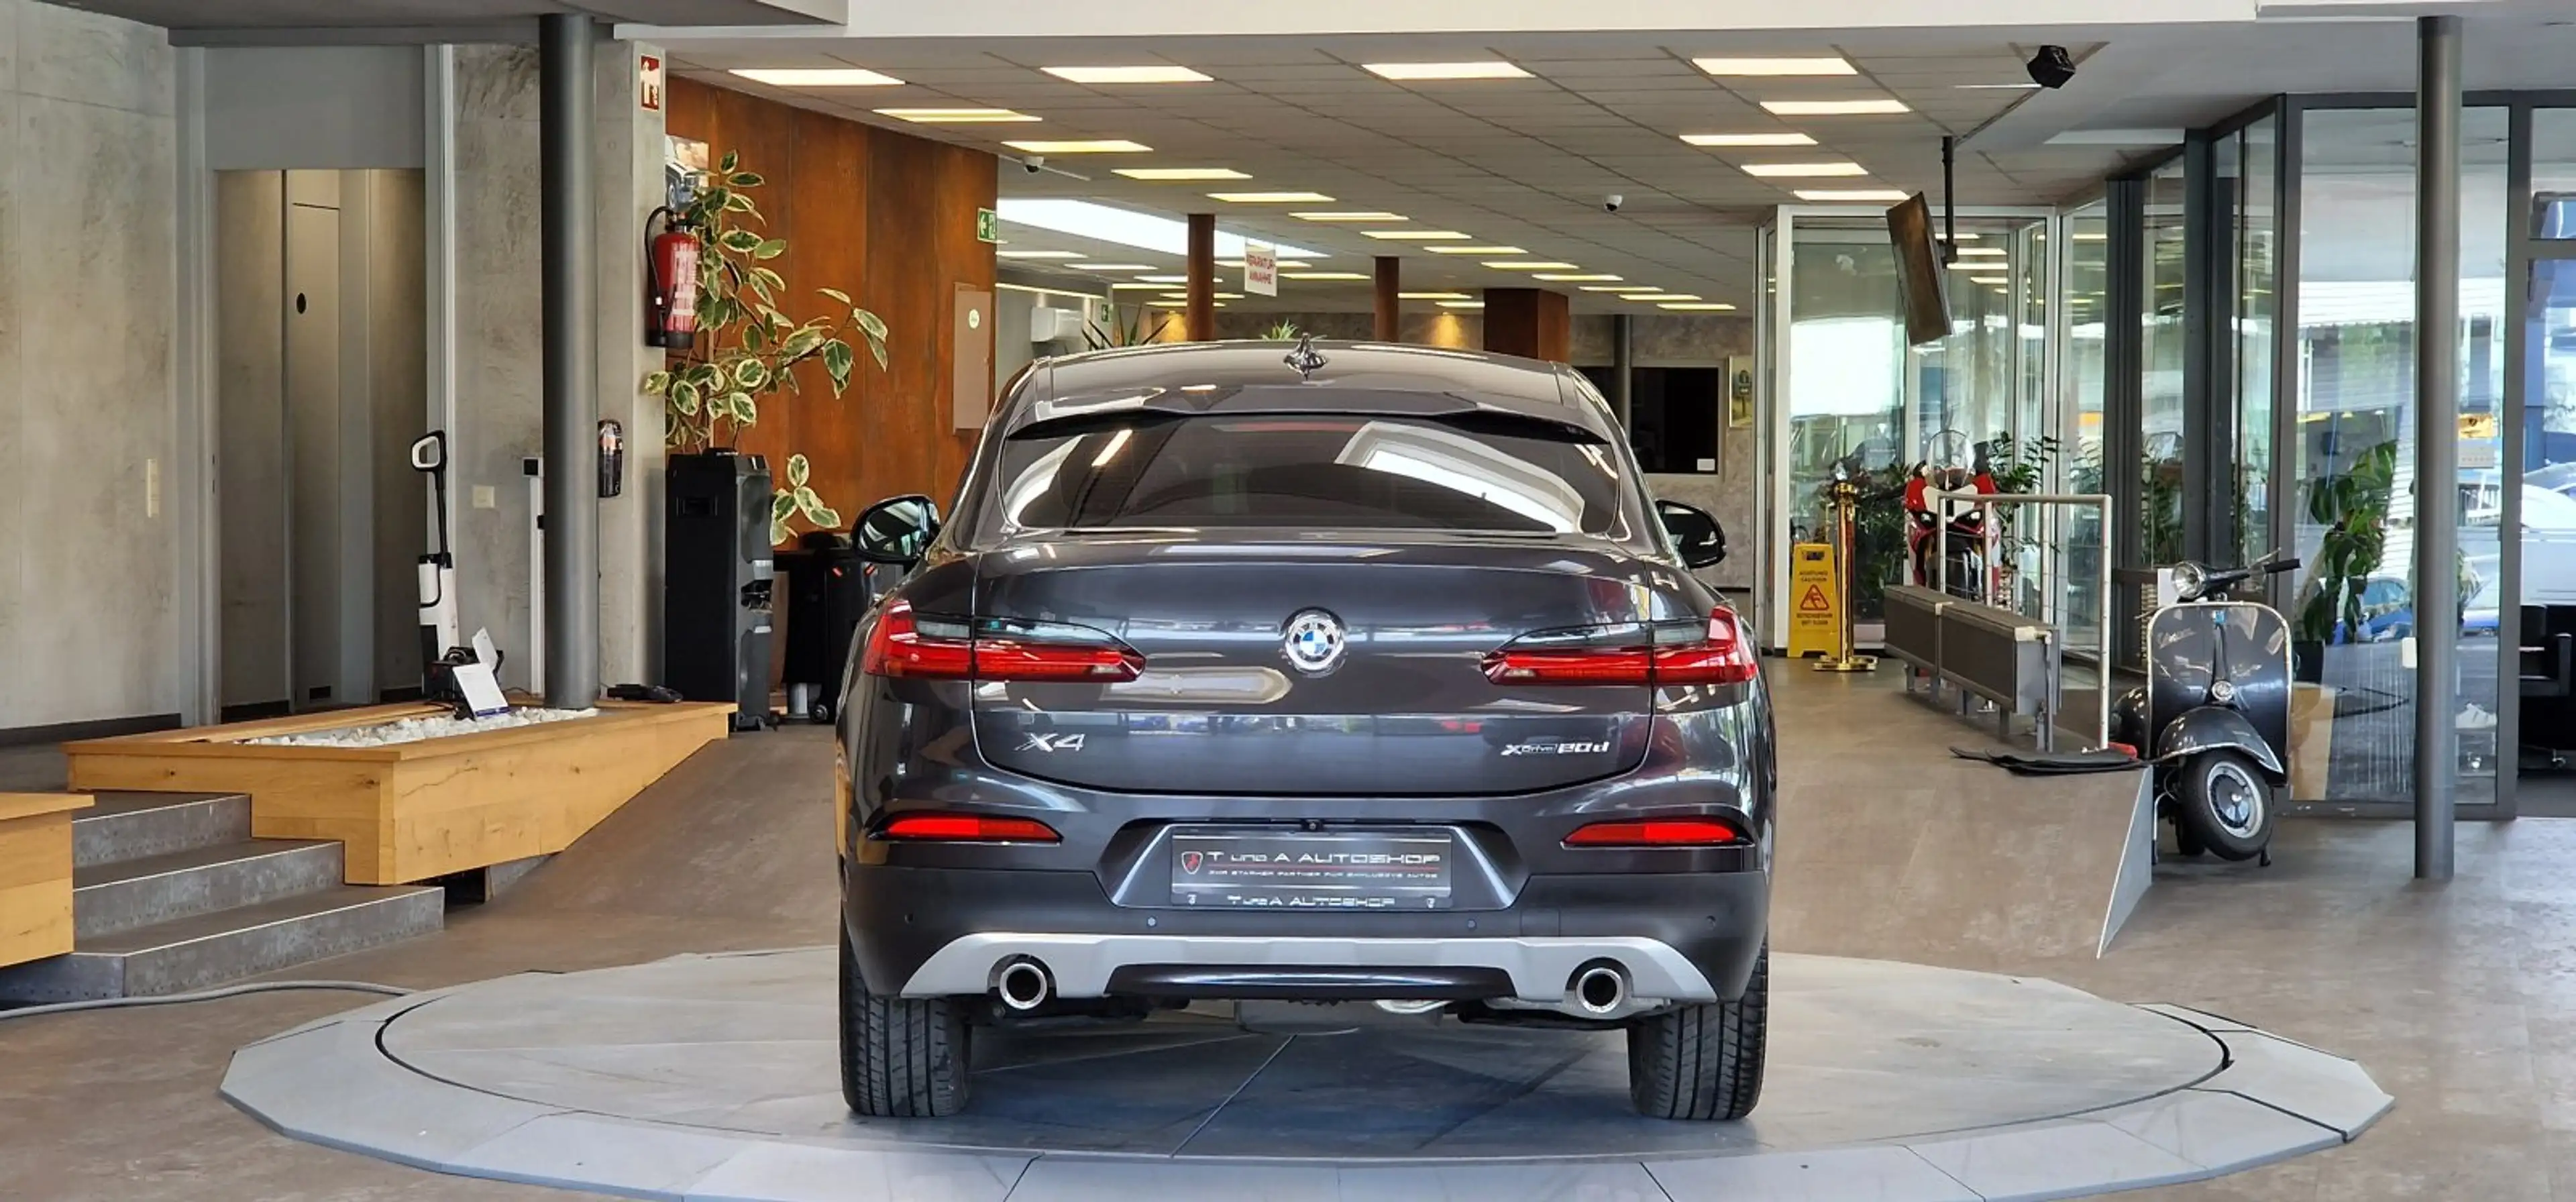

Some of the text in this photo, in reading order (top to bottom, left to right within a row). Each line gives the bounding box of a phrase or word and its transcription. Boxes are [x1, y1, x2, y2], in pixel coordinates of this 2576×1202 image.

[1014, 731, 1085, 752] X4
[1207, 851, 1224, 861] T
[1274, 853, 1291, 862] A
[1298, 853, 1440, 864] AUTOSHOP
[1227, 894, 1241, 905] T
[1269, 897, 1283, 906] A
[1289, 896, 1395, 907] AUTOSHOP
